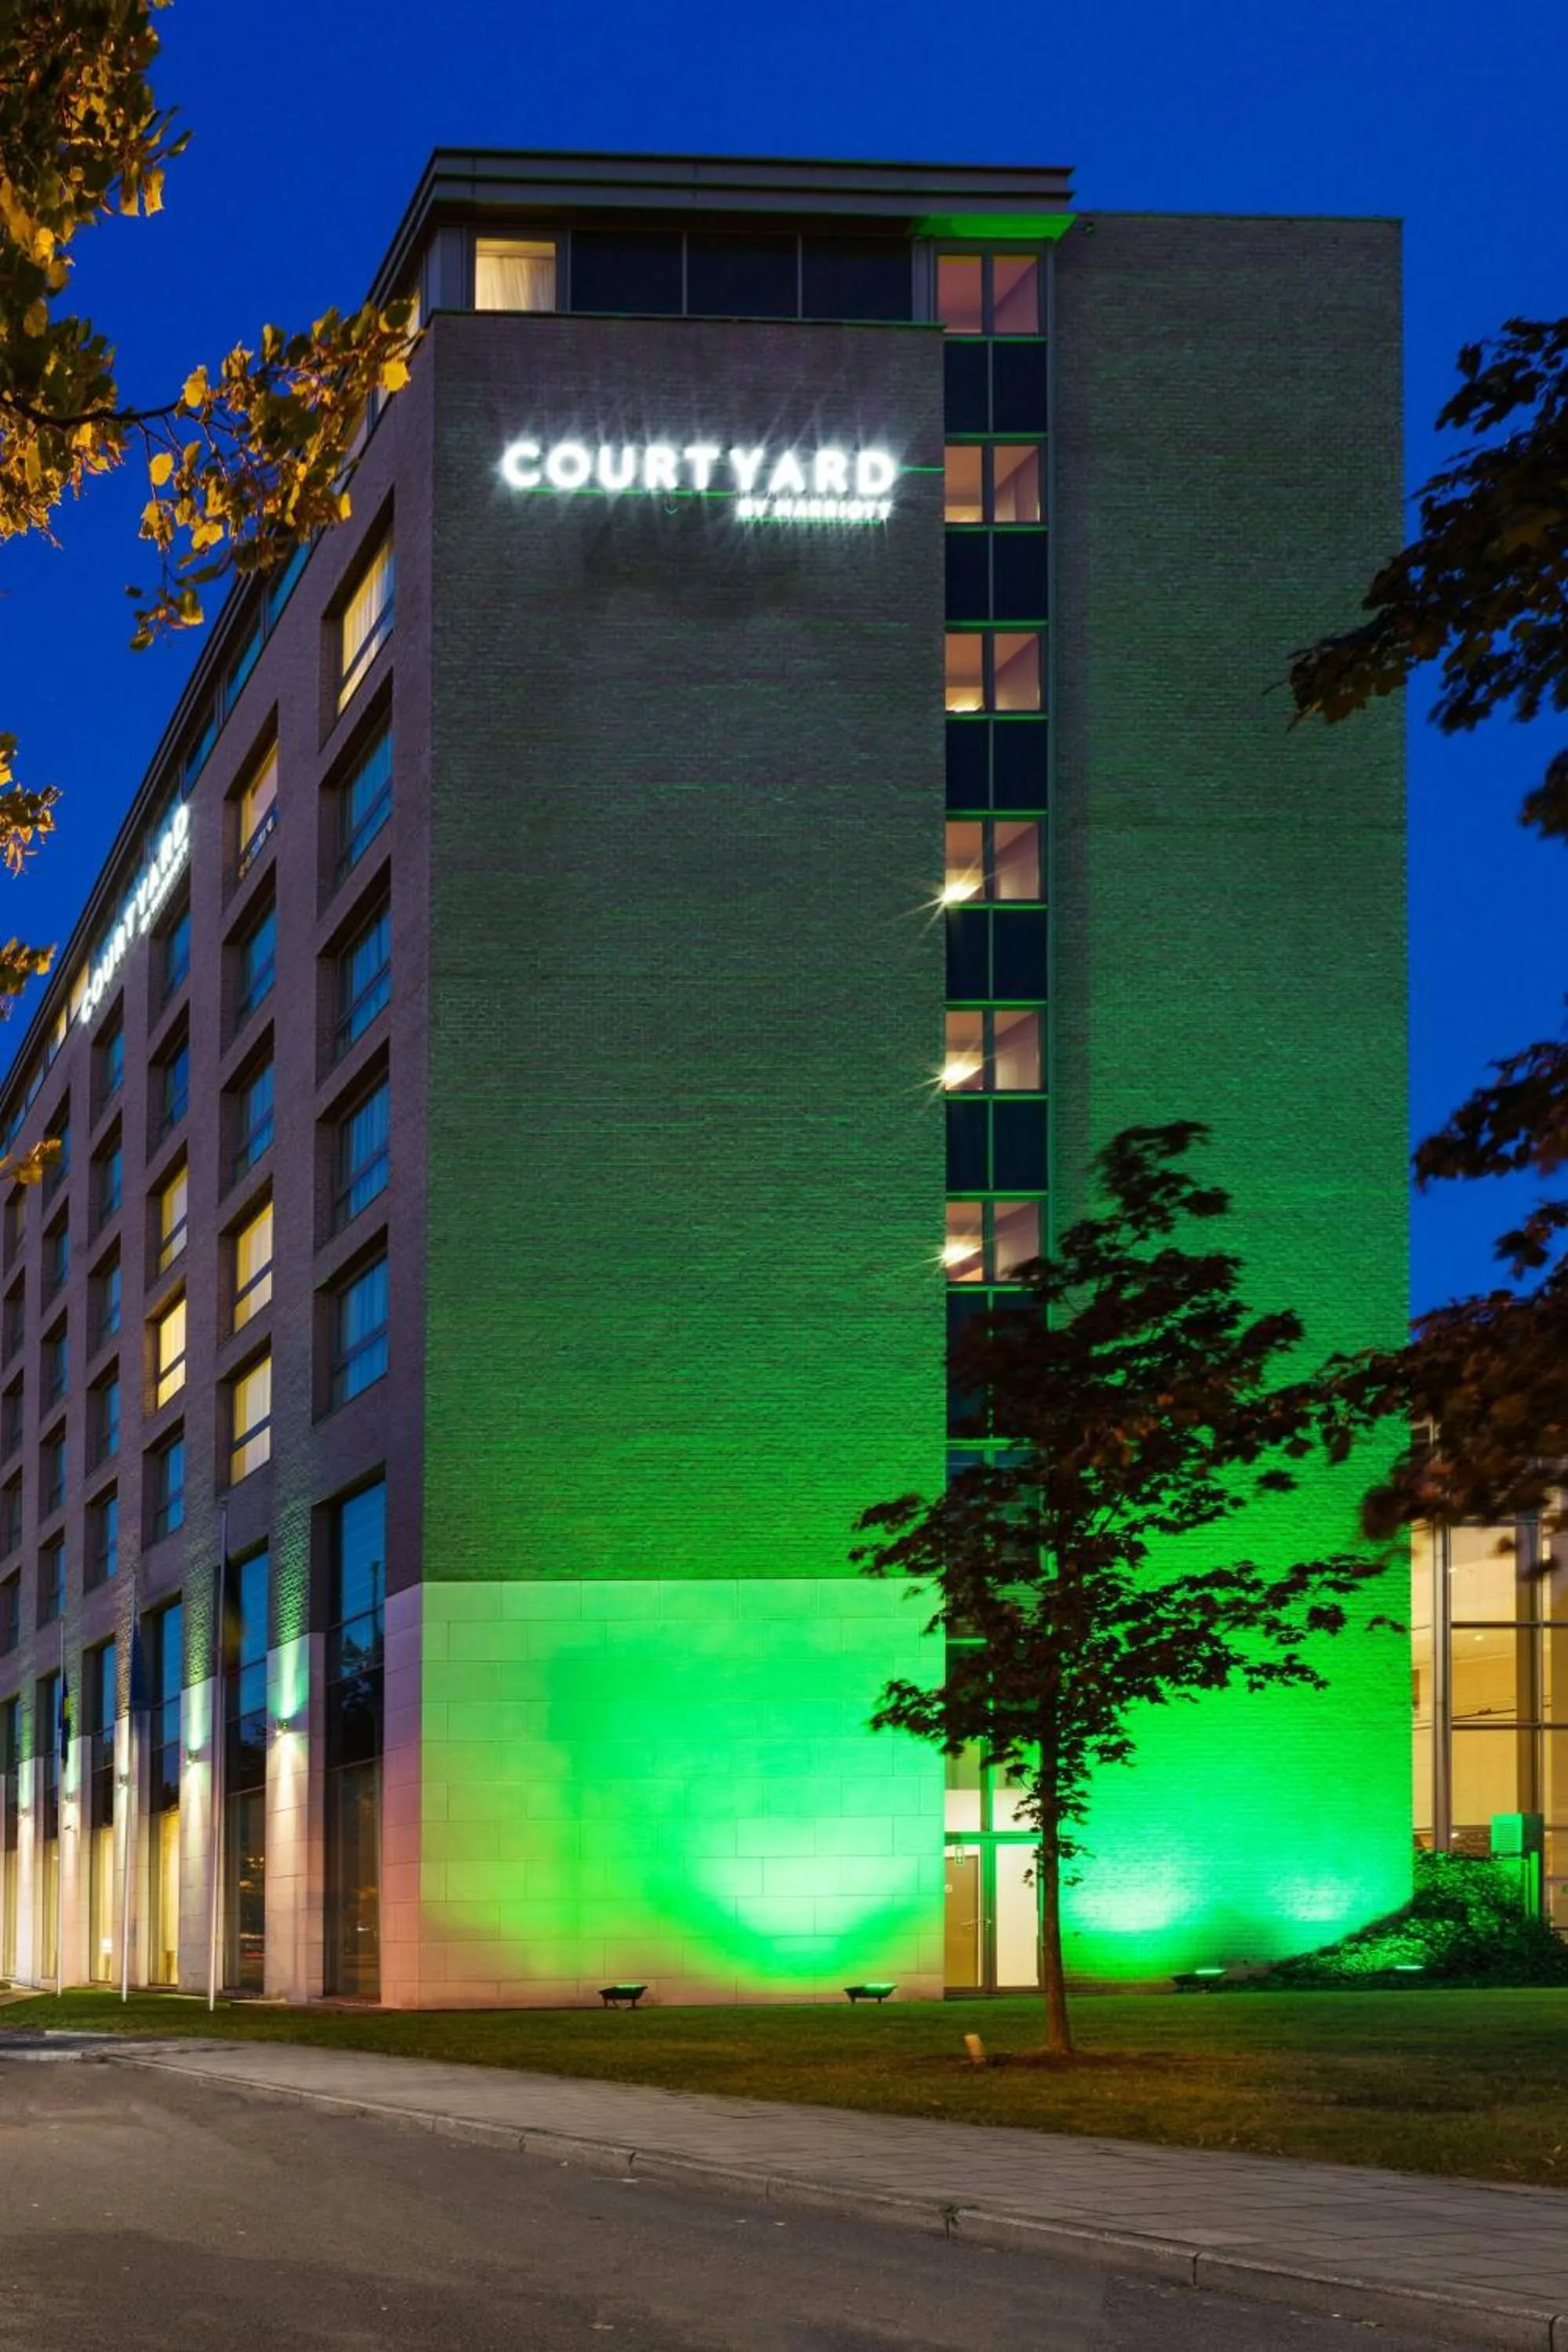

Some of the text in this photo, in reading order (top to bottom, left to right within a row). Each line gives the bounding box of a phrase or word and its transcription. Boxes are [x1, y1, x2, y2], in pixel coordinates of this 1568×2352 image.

[502, 443, 896, 493] COURTYARD
[737, 499, 892, 521] BY MARRIOTT
[81, 803, 189, 1023] COURTYARD
